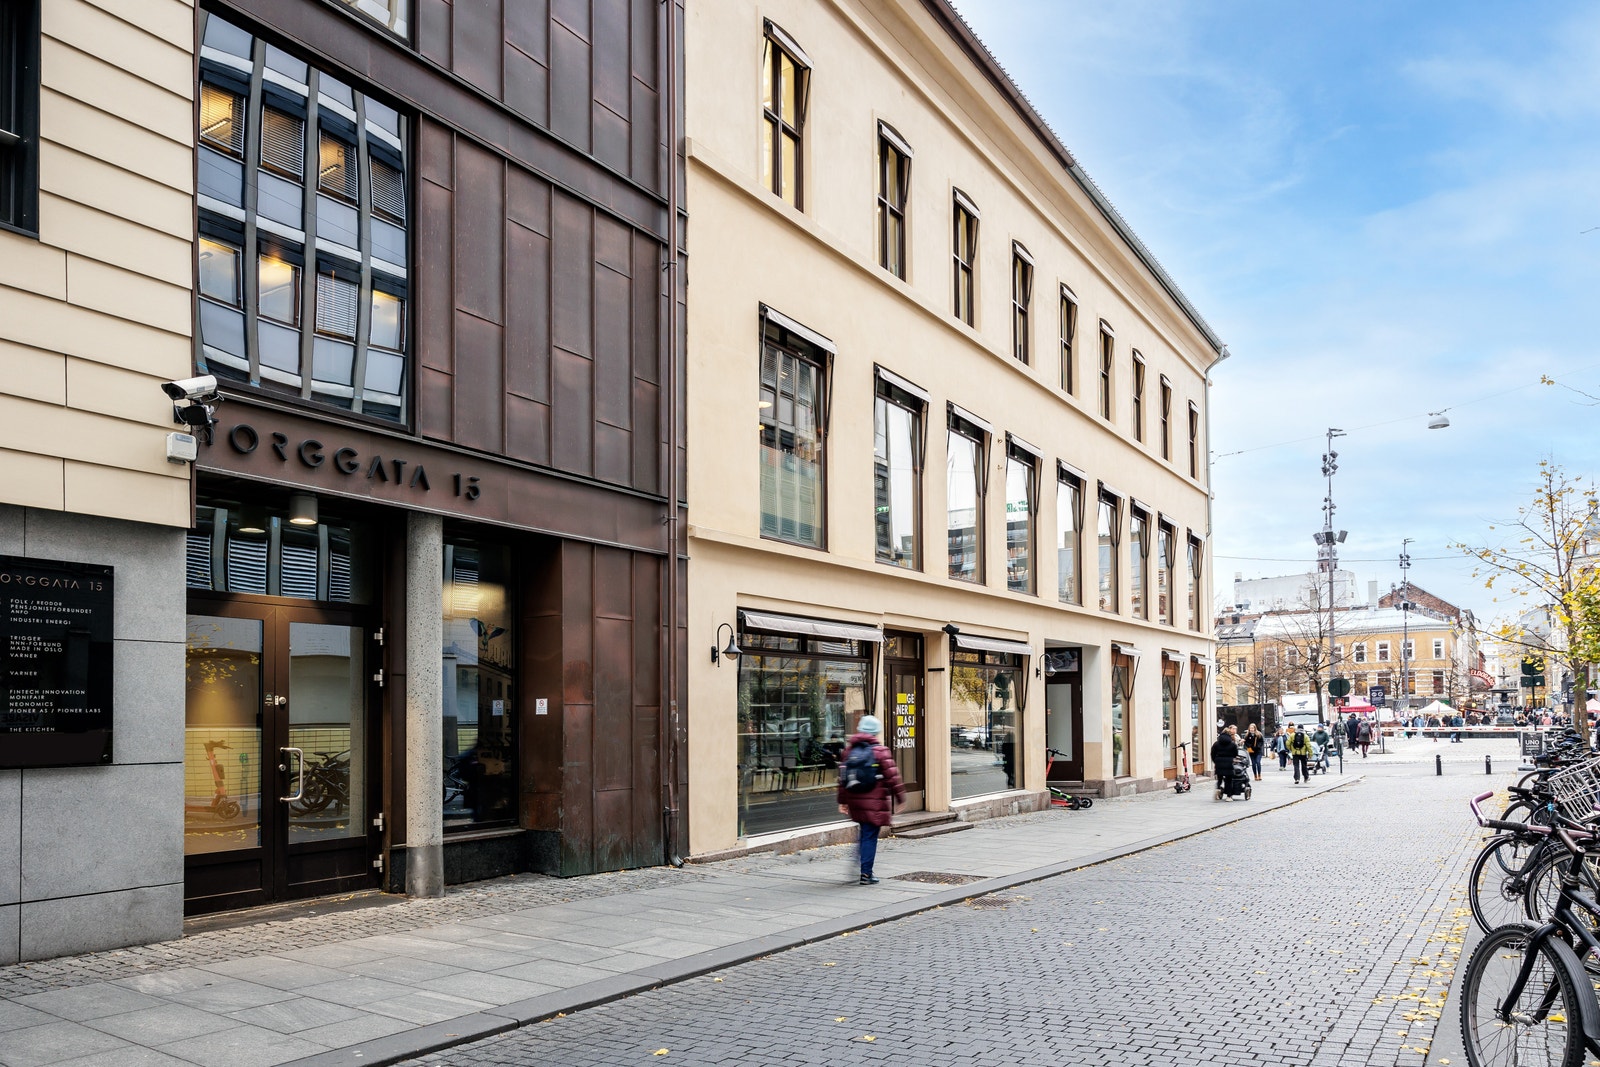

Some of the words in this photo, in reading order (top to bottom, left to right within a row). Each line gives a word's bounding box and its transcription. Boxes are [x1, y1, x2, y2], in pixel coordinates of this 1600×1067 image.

[453, 472, 481, 500] 15
[0, 574, 80, 589] ORGGATA
[90, 582, 102, 591] 15
[10, 604, 92, 614] PENSJONISTFORBUNDET
[907, 693, 914, 703] GE
[896, 705, 908, 714] NER
[904, 716, 914, 725] ASJ
[897, 727, 909, 737] ONS
